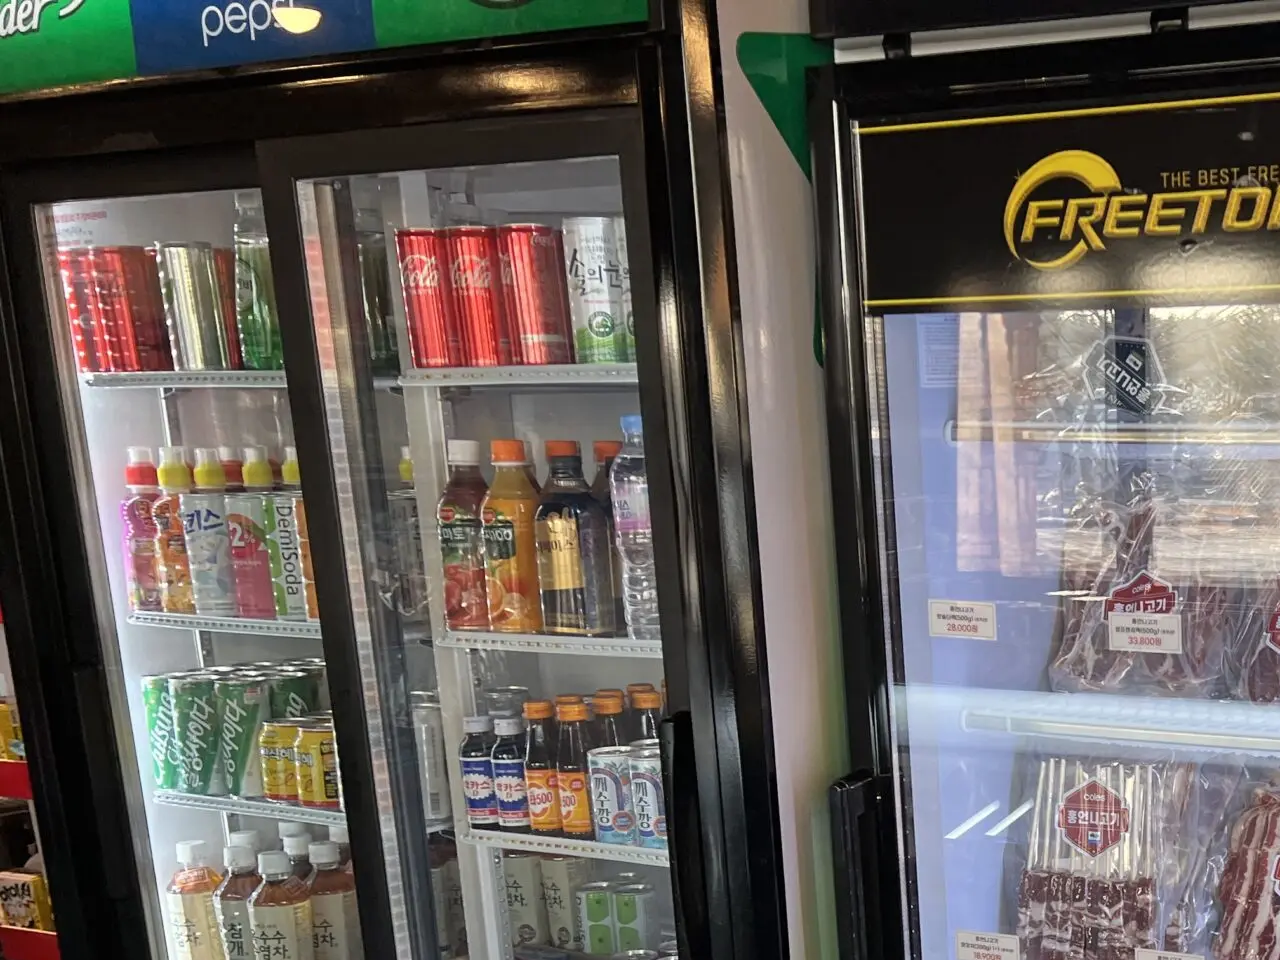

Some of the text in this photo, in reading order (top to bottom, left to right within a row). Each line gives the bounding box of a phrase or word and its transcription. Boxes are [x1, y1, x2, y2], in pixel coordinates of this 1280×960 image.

[1160, 171, 1194, 188] THE
[1198, 167, 1240, 187] BEST
[276, 506, 302, 596] DemiSoda
